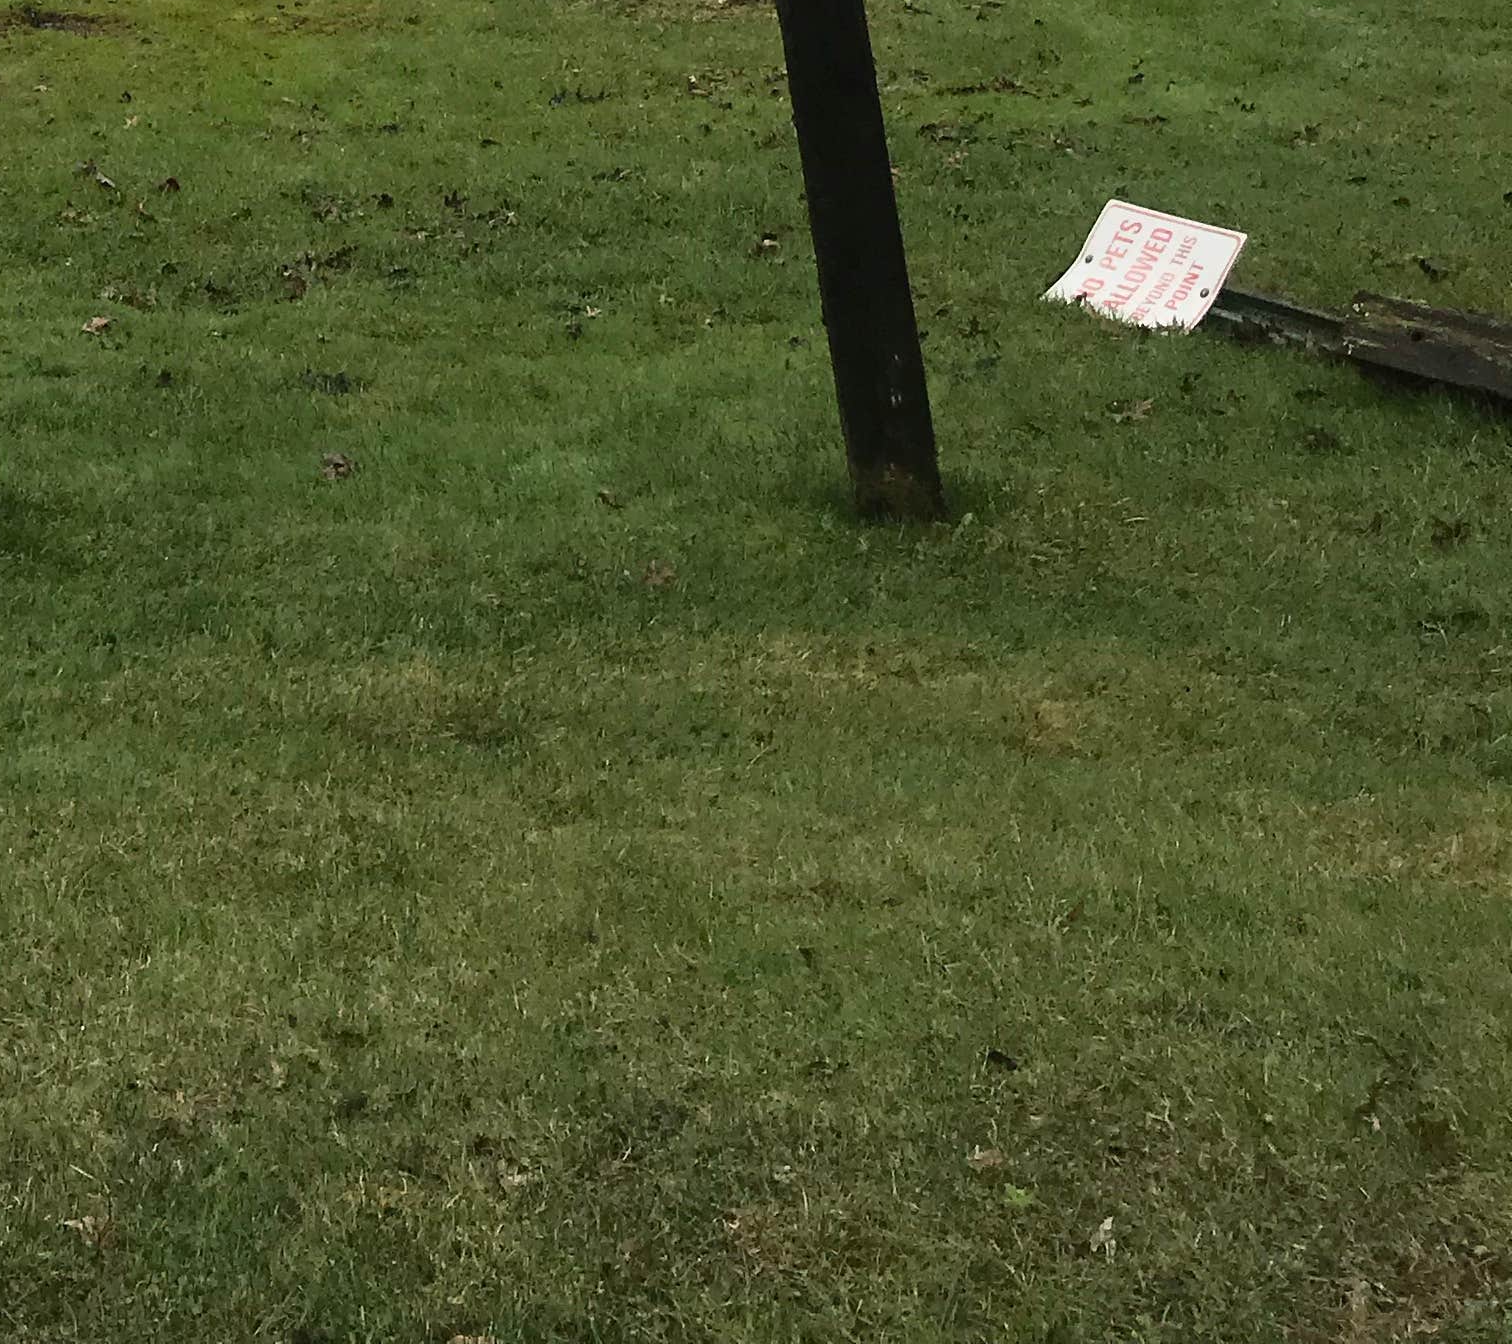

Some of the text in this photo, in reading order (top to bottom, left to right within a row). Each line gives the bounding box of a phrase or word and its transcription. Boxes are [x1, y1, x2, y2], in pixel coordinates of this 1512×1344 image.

[1100, 219, 1143, 271] PETS
[1101, 227, 1174, 310] ALLOWED
[1129, 234, 1198, 321] BEYOND THIS
[1164, 262, 1204, 311] POINT
